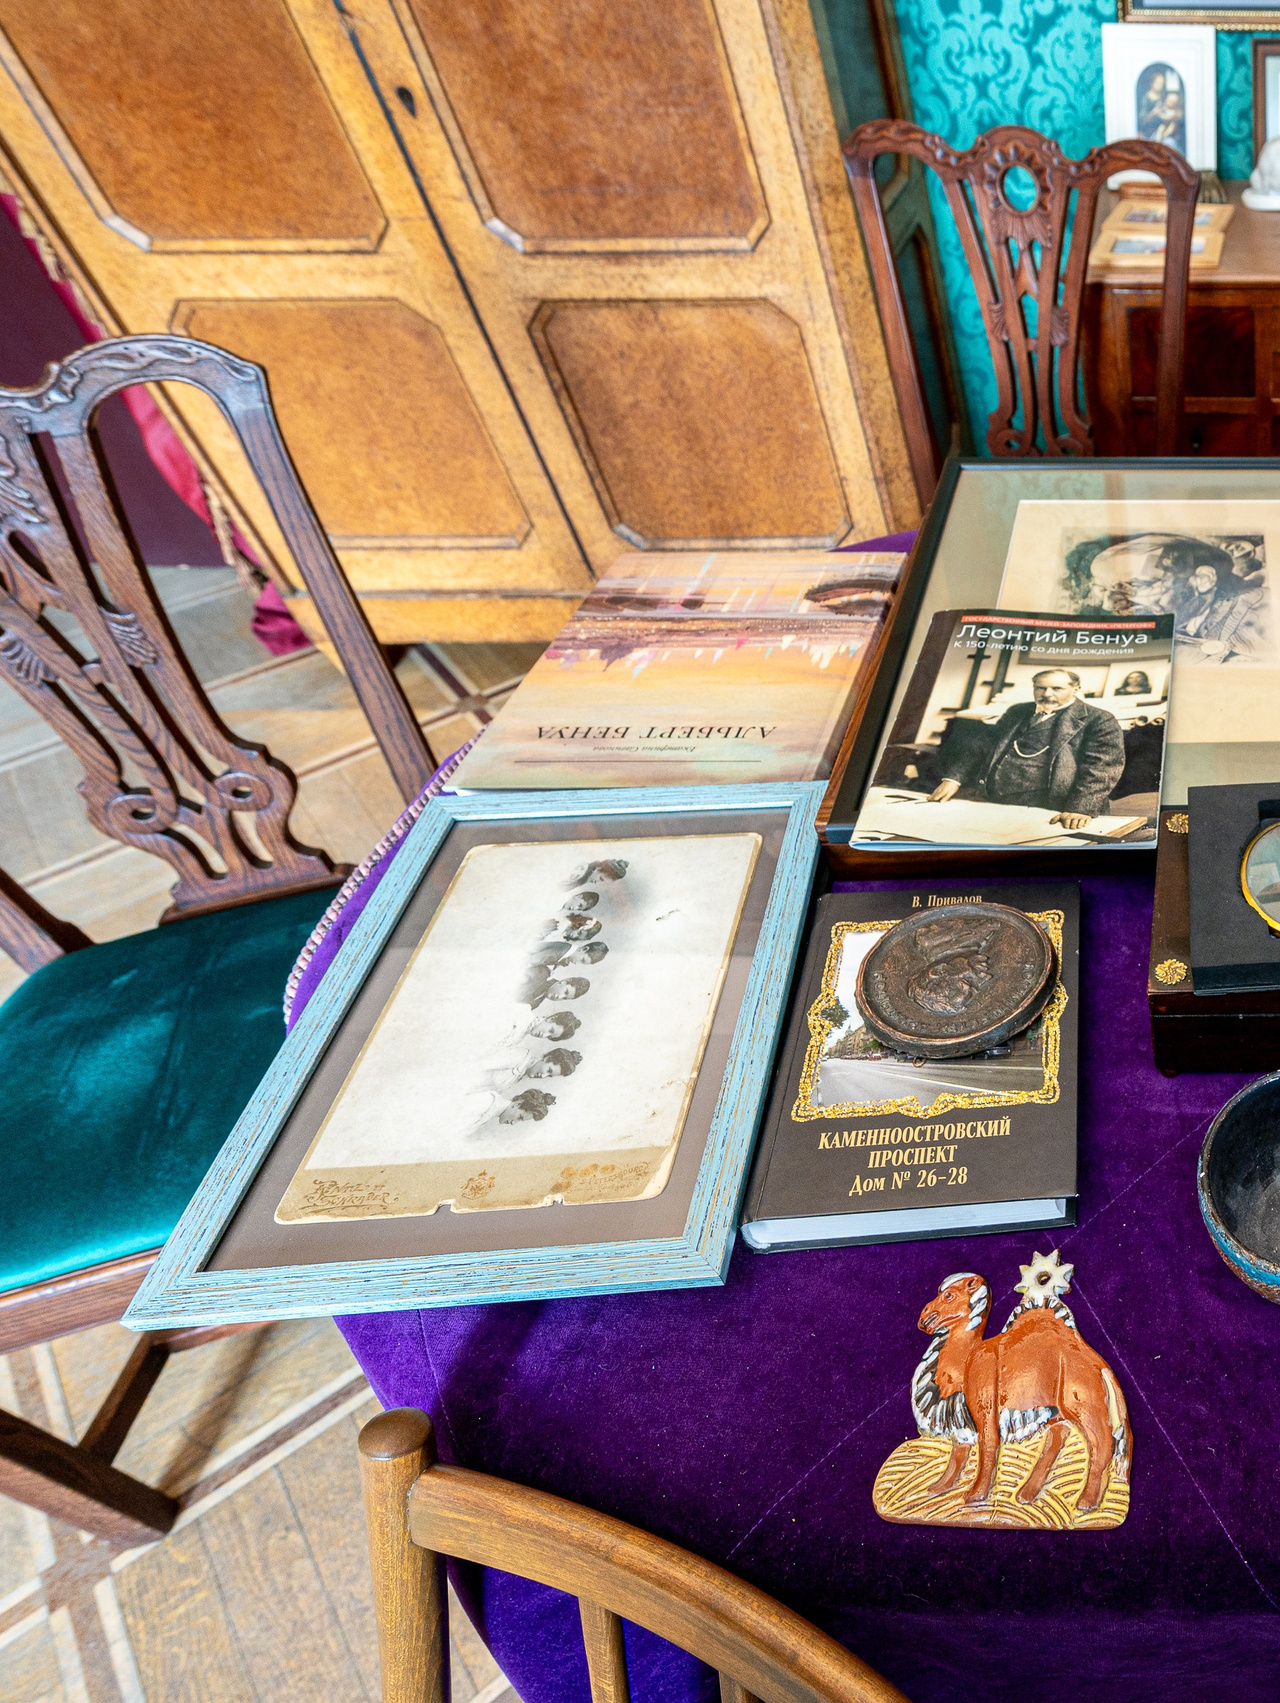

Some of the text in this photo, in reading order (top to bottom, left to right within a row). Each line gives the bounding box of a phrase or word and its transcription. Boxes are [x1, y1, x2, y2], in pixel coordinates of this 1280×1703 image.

[957, 623, 1148, 646] Леонтий Бенуа
[953, 640, 1135, 656] К 150-летию со дня рождения
[537, 725, 777, 740] АЛЬБЕРТ БЕНУА
[911, 894, 983, 908] В. Привалов
[817, 1115, 1012, 1150] КАМЕННООСТРОВСКИЙ
[867, 1145, 958, 1169] ПРОСПЕКТ
[848, 1166, 968, 1197] Дом № 26-28
